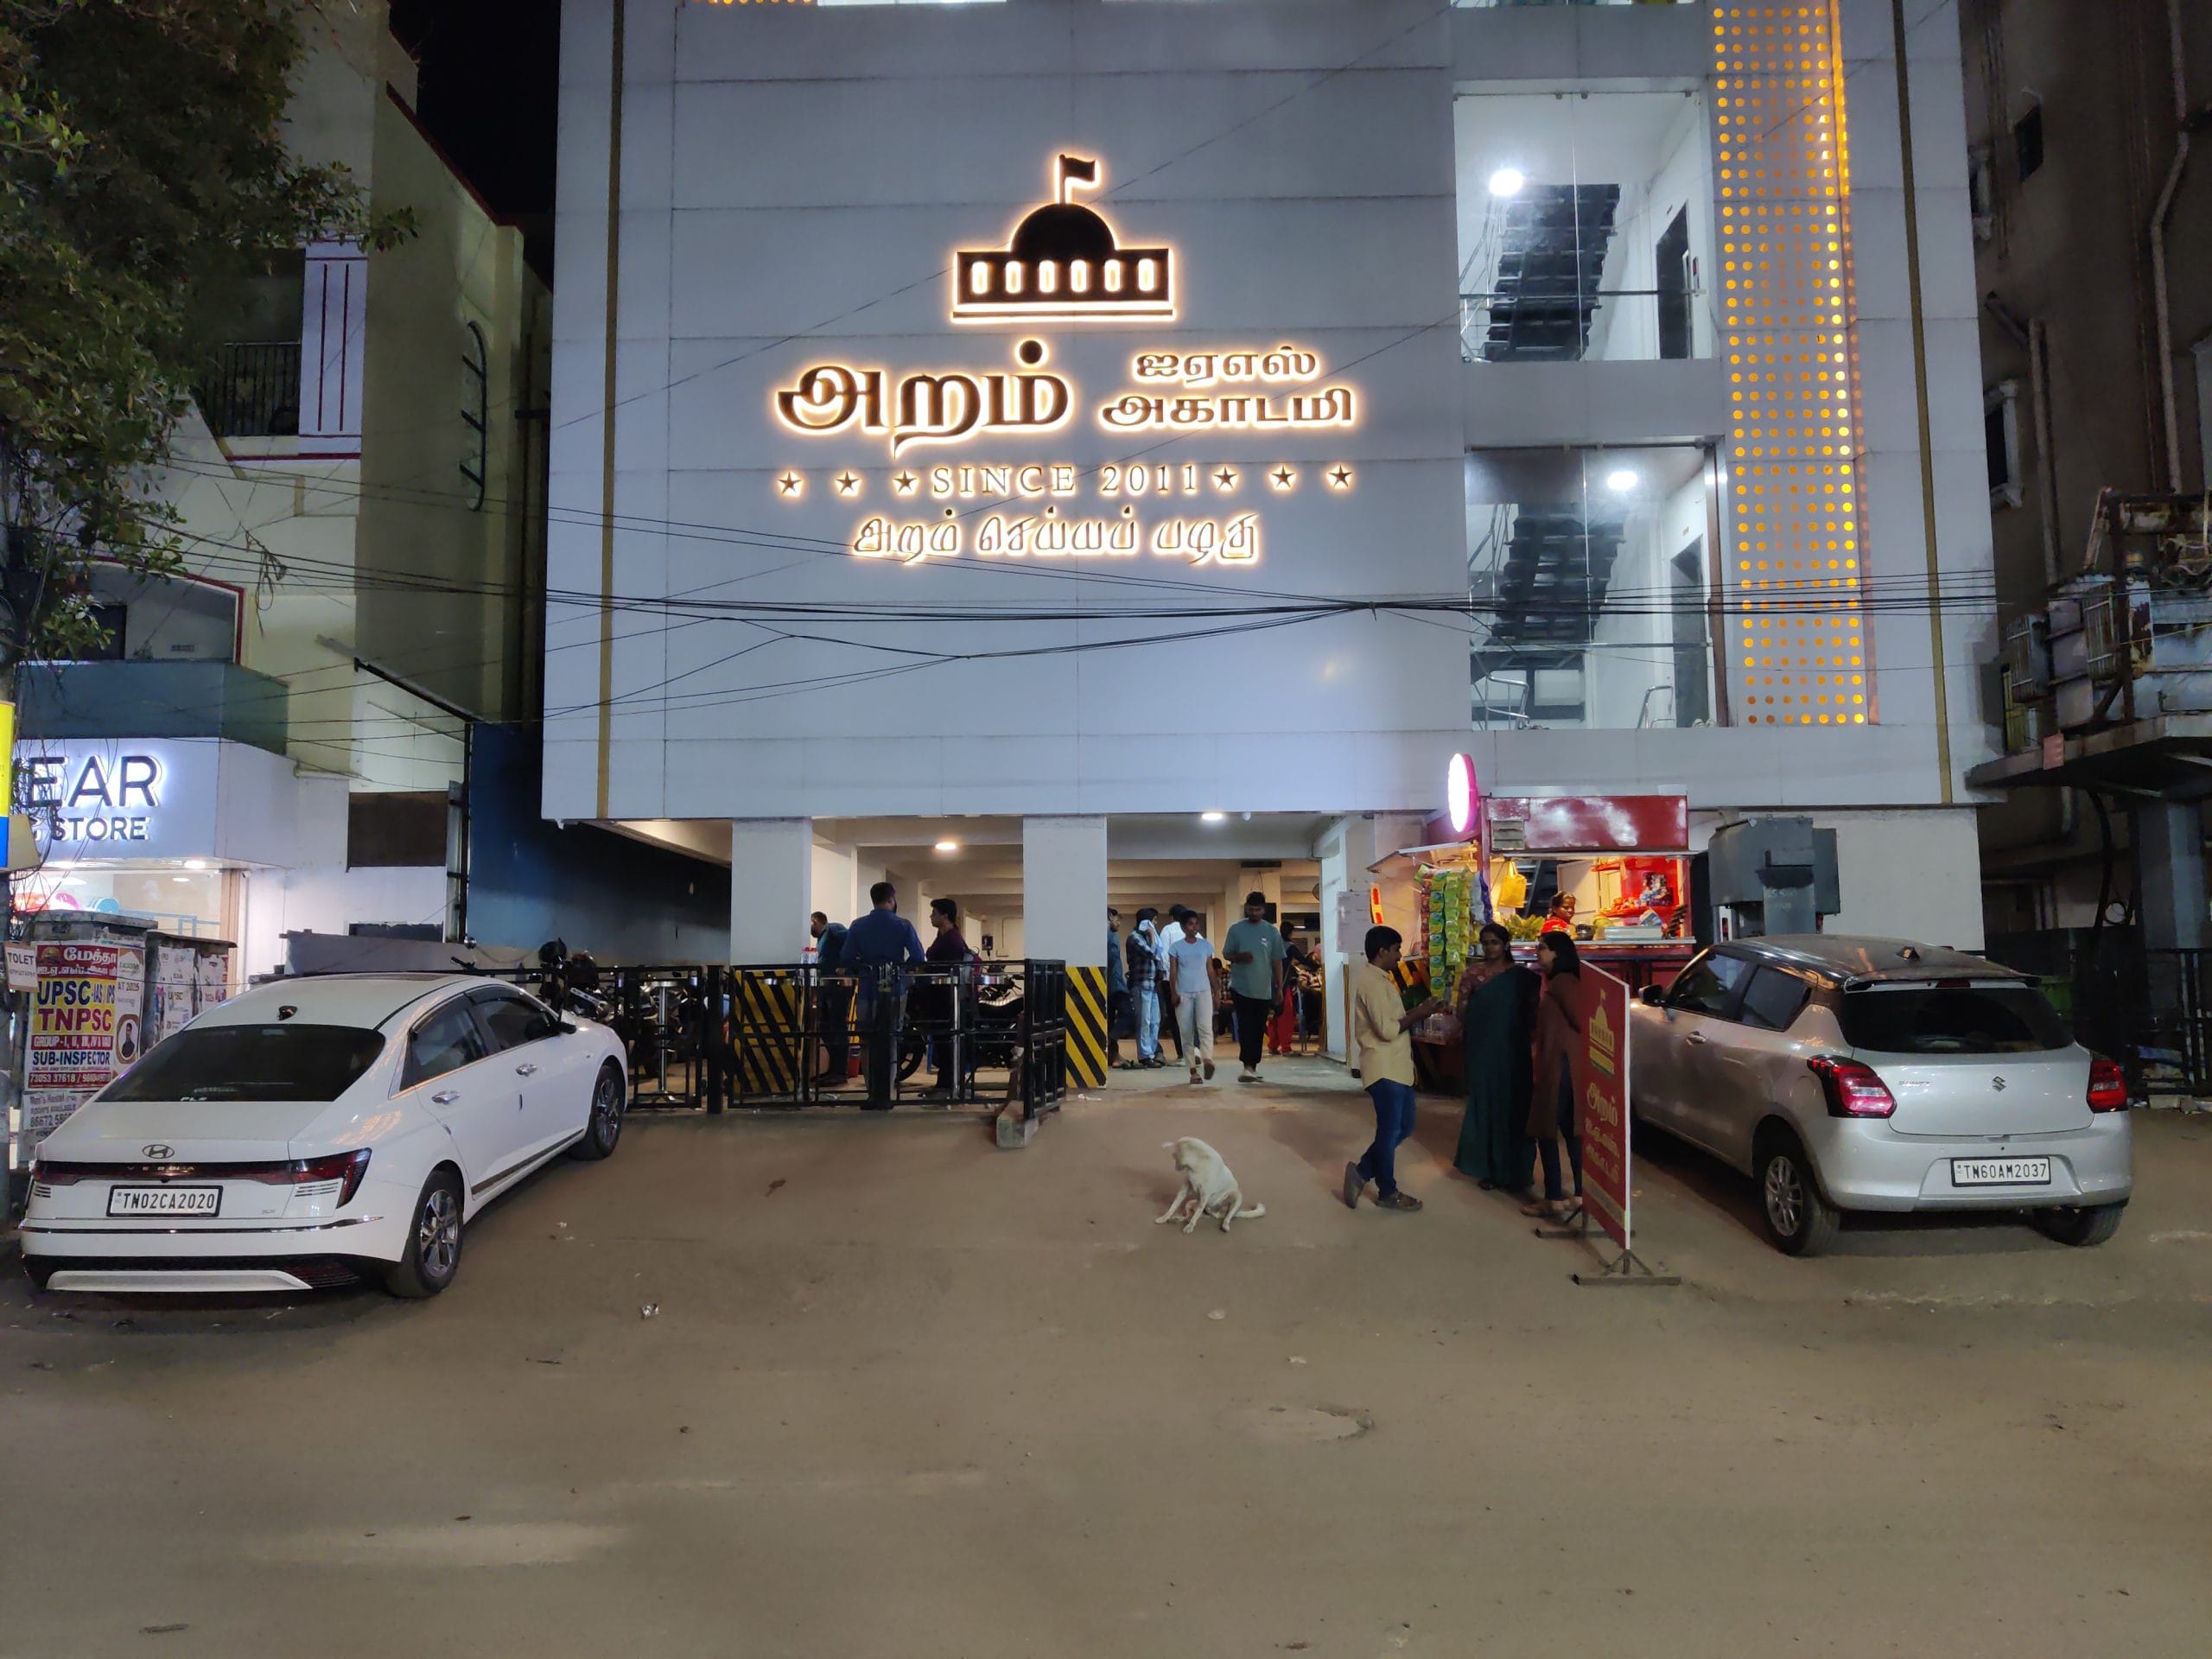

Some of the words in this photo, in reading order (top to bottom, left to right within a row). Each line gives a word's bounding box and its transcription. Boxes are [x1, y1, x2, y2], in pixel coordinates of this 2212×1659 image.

[1136, 346, 1317, 384] ஐஏஎஸ்
[777, 340, 1069, 461] அறம்
[1102, 388, 1352, 427] அகாடமி
[933, 466, 1075, 493] SINCE
[1103, 465, 1197, 492] 2011
[854, 507, 959, 563] அறம்
[977, 505, 1135, 553] செய்யப்
[1156, 513, 1259, 565] பழகு
[52, 817, 147, 841] STORE
[38, 1007, 111, 1031] TNPSC
[32, 1051, 111, 1065] SUB-INSPECTOR
[1964, 1163, 2047, 1179] TN60AM2037
[123, 1193, 215, 1210] TN02CA2020
